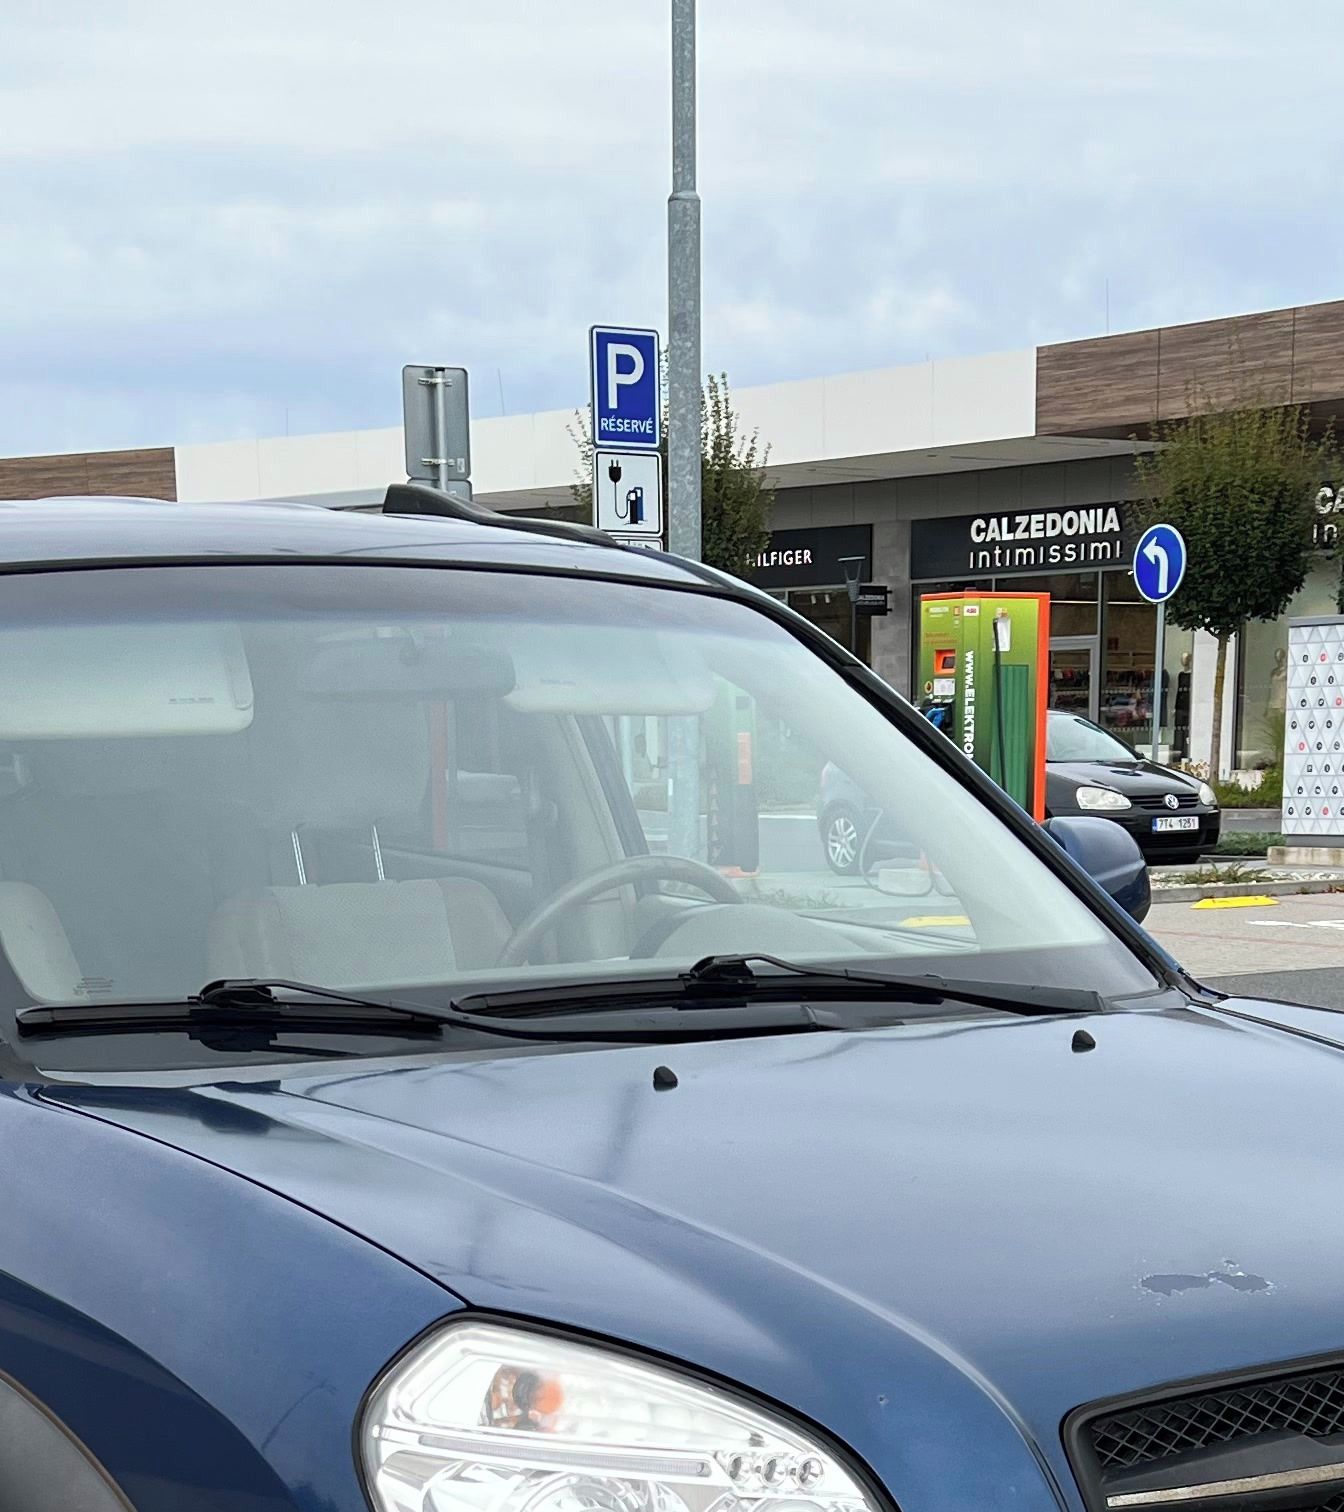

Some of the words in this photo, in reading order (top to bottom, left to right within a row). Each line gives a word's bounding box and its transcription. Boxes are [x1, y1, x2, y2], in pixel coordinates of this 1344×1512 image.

[607, 343, 644, 409] P
[600, 415, 654, 434] RÉSERVÉ
[970, 507, 1121, 543] CALZEDONIA
[969, 540, 1121, 569] intimissimi
